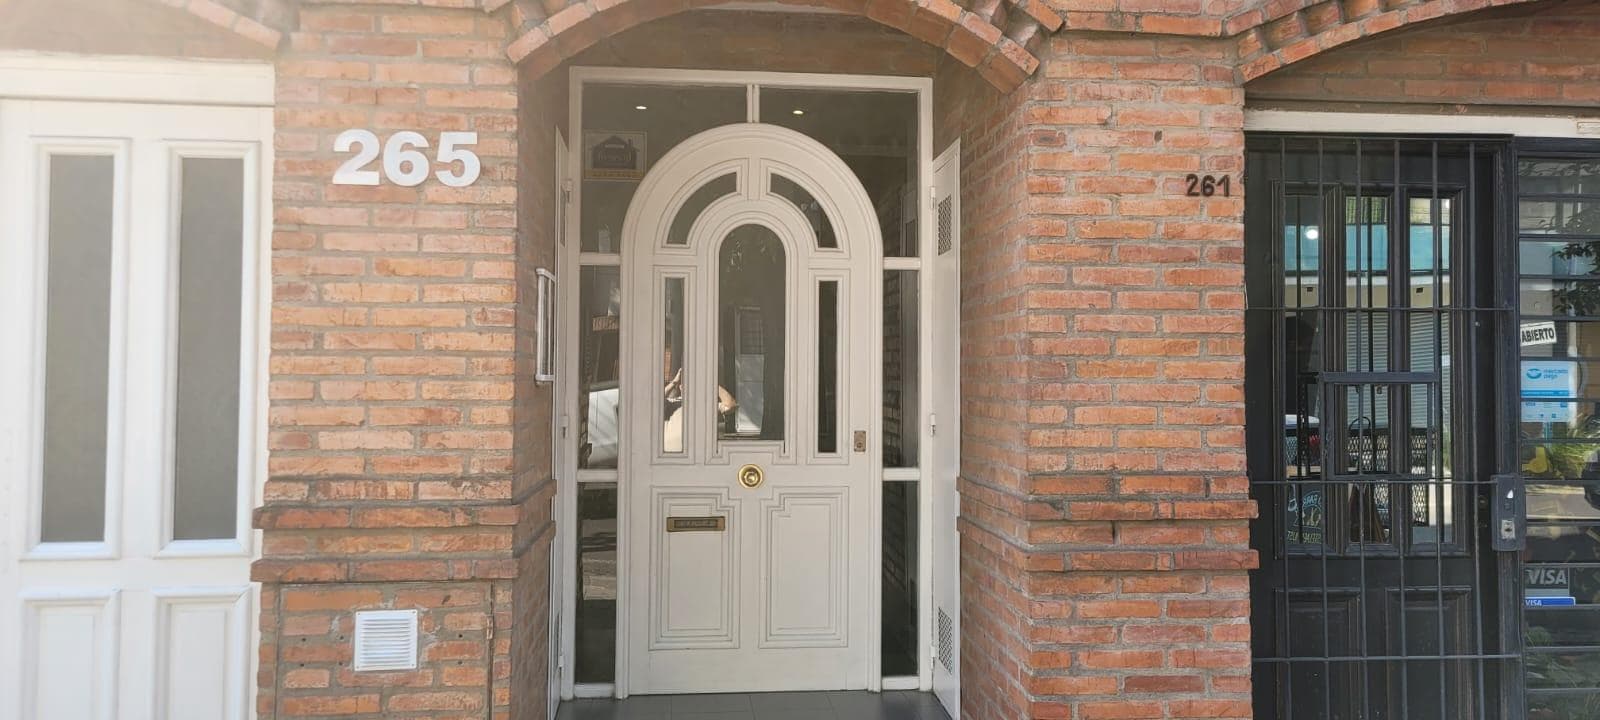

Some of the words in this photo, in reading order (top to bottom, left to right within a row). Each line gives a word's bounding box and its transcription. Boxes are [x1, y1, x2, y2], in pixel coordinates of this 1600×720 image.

[332, 129, 481, 187] 265
[1186, 173, 1230, 197] 261
[1521, 327, 1555, 343] ABIERTO
[1525, 568, 1567, 585] VISA
